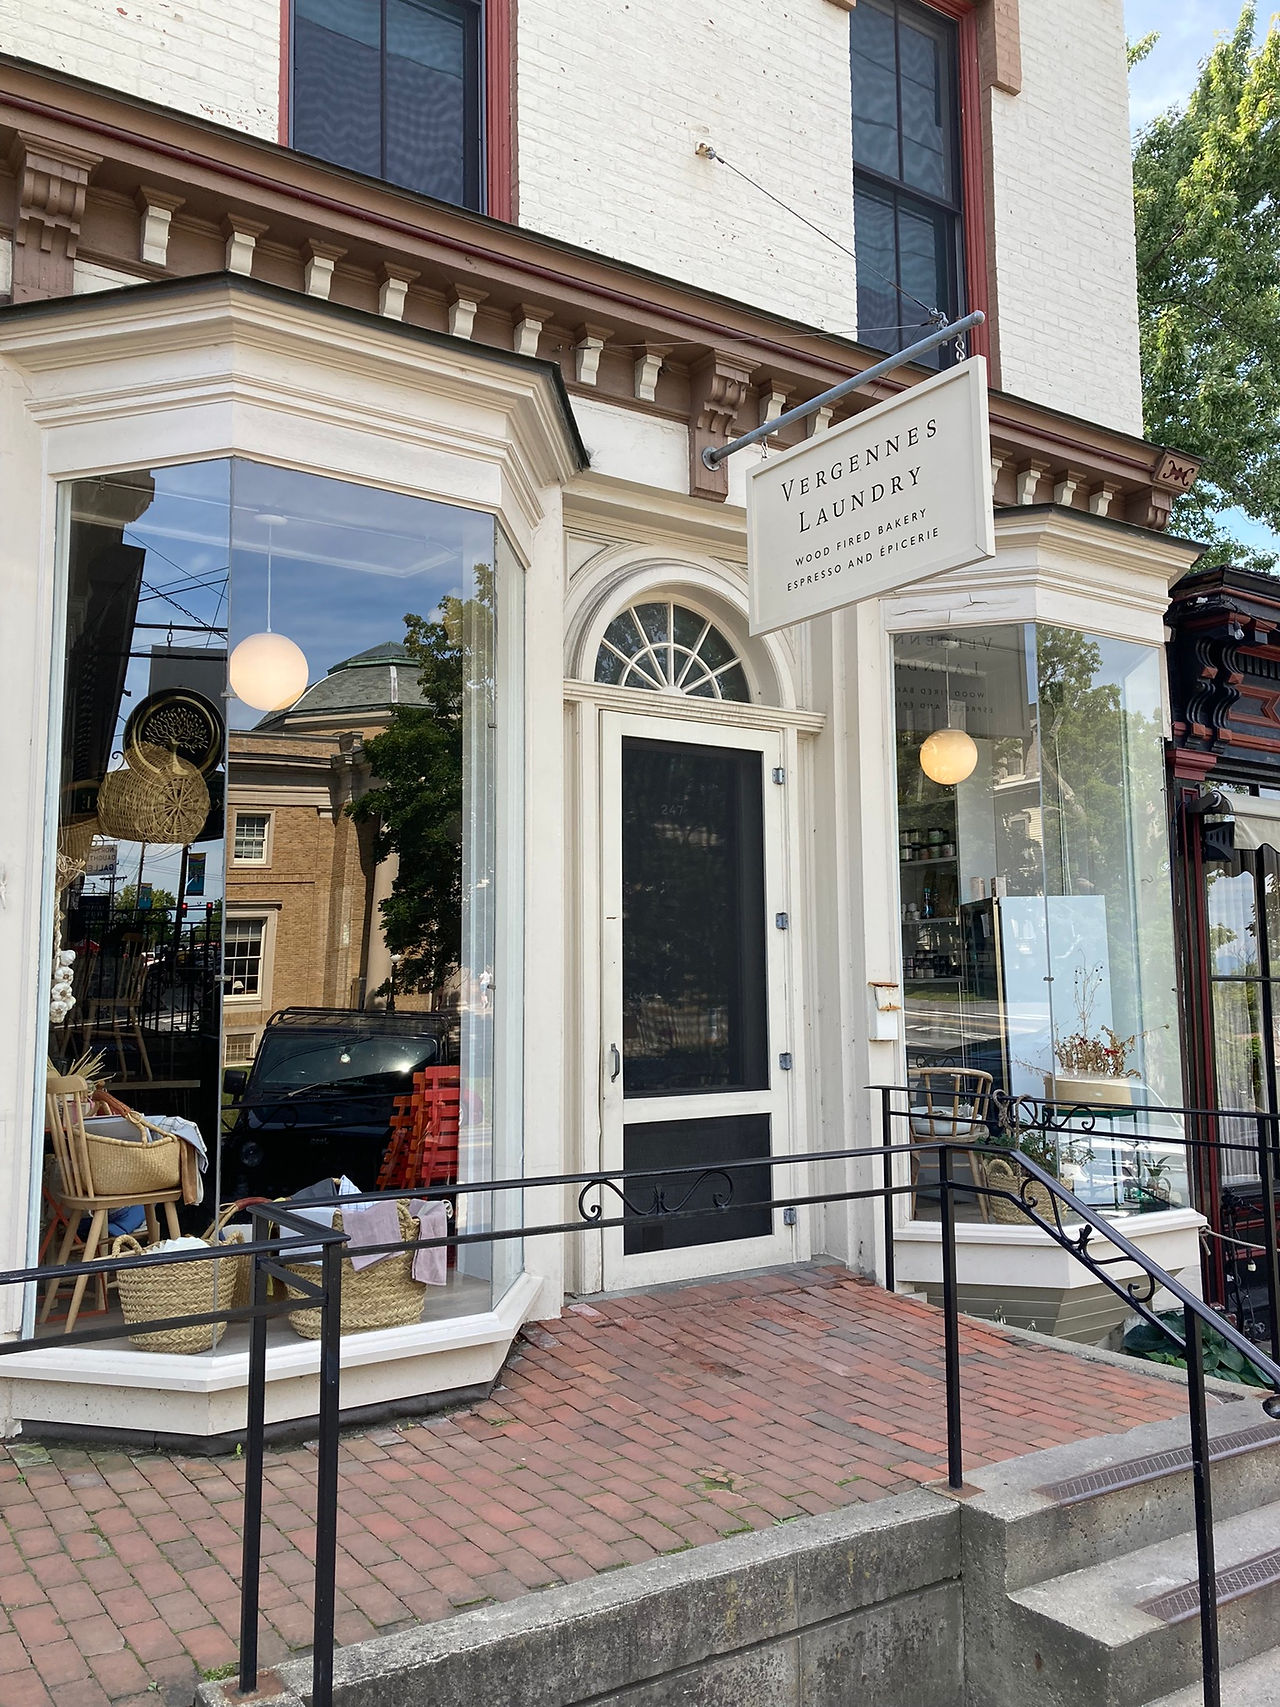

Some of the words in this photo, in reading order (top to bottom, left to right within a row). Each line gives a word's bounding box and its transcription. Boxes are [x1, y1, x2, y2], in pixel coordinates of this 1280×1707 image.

[781, 418, 937, 502] VERGENNES
[799, 466, 922, 533] LAUNDRY
[787, 564, 842, 592] ESPRESSO
[847, 553, 873, 569] AND
[880, 527, 940, 557] ÉPICERIE
[795, 546, 831, 566] WOOD
[836, 530, 871, 551] FIRED
[878, 508, 927, 535] BAKERY
[660, 803, 683, 817] 247
